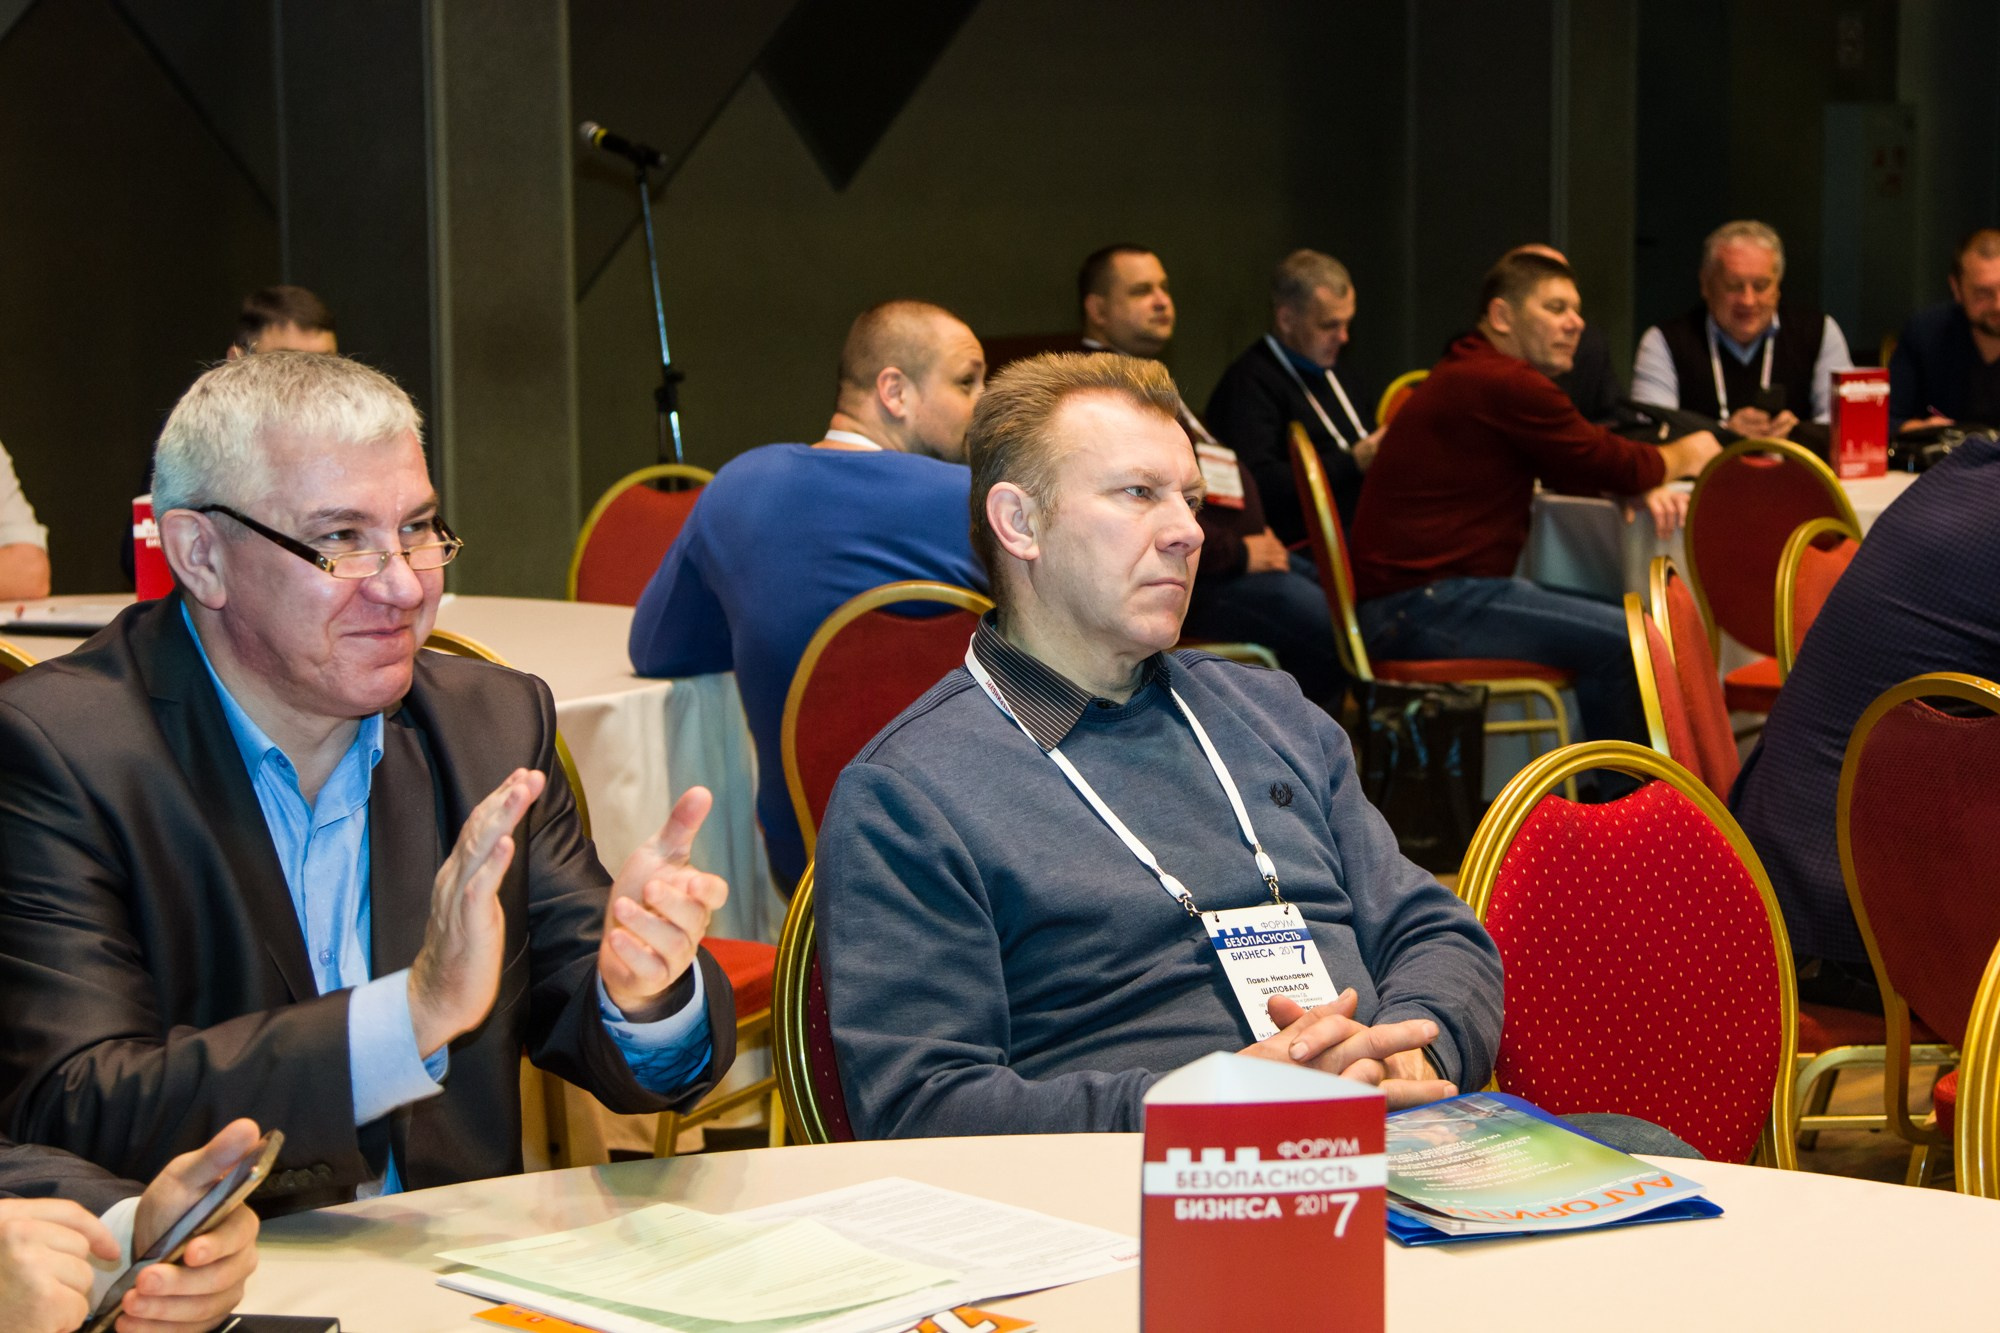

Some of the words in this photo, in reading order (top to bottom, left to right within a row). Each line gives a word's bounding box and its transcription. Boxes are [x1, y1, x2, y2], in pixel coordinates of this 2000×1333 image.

[1261, 920, 1295, 929] ФОРУМ
[1224, 931, 1302, 948] БЕЗОПАСНОСТЬ
[1231, 949, 1276, 961] БИЗНЕСА
[1279, 945, 1306, 965] 2017
[1246, 977, 1270, 985] Павел
[1271, 972, 1314, 982] Николаевич
[1261, 983, 1310, 995] ШАПОВАЛОВ
[1276, 1137, 1361, 1159] ФОРУМ
[1175, 1166, 1359, 1189] БЕЗОПАСНОСТЬ
[1174, 1197, 1283, 1220] БИЗНЕСА
[1294, 1192, 1360, 1239] 2017
